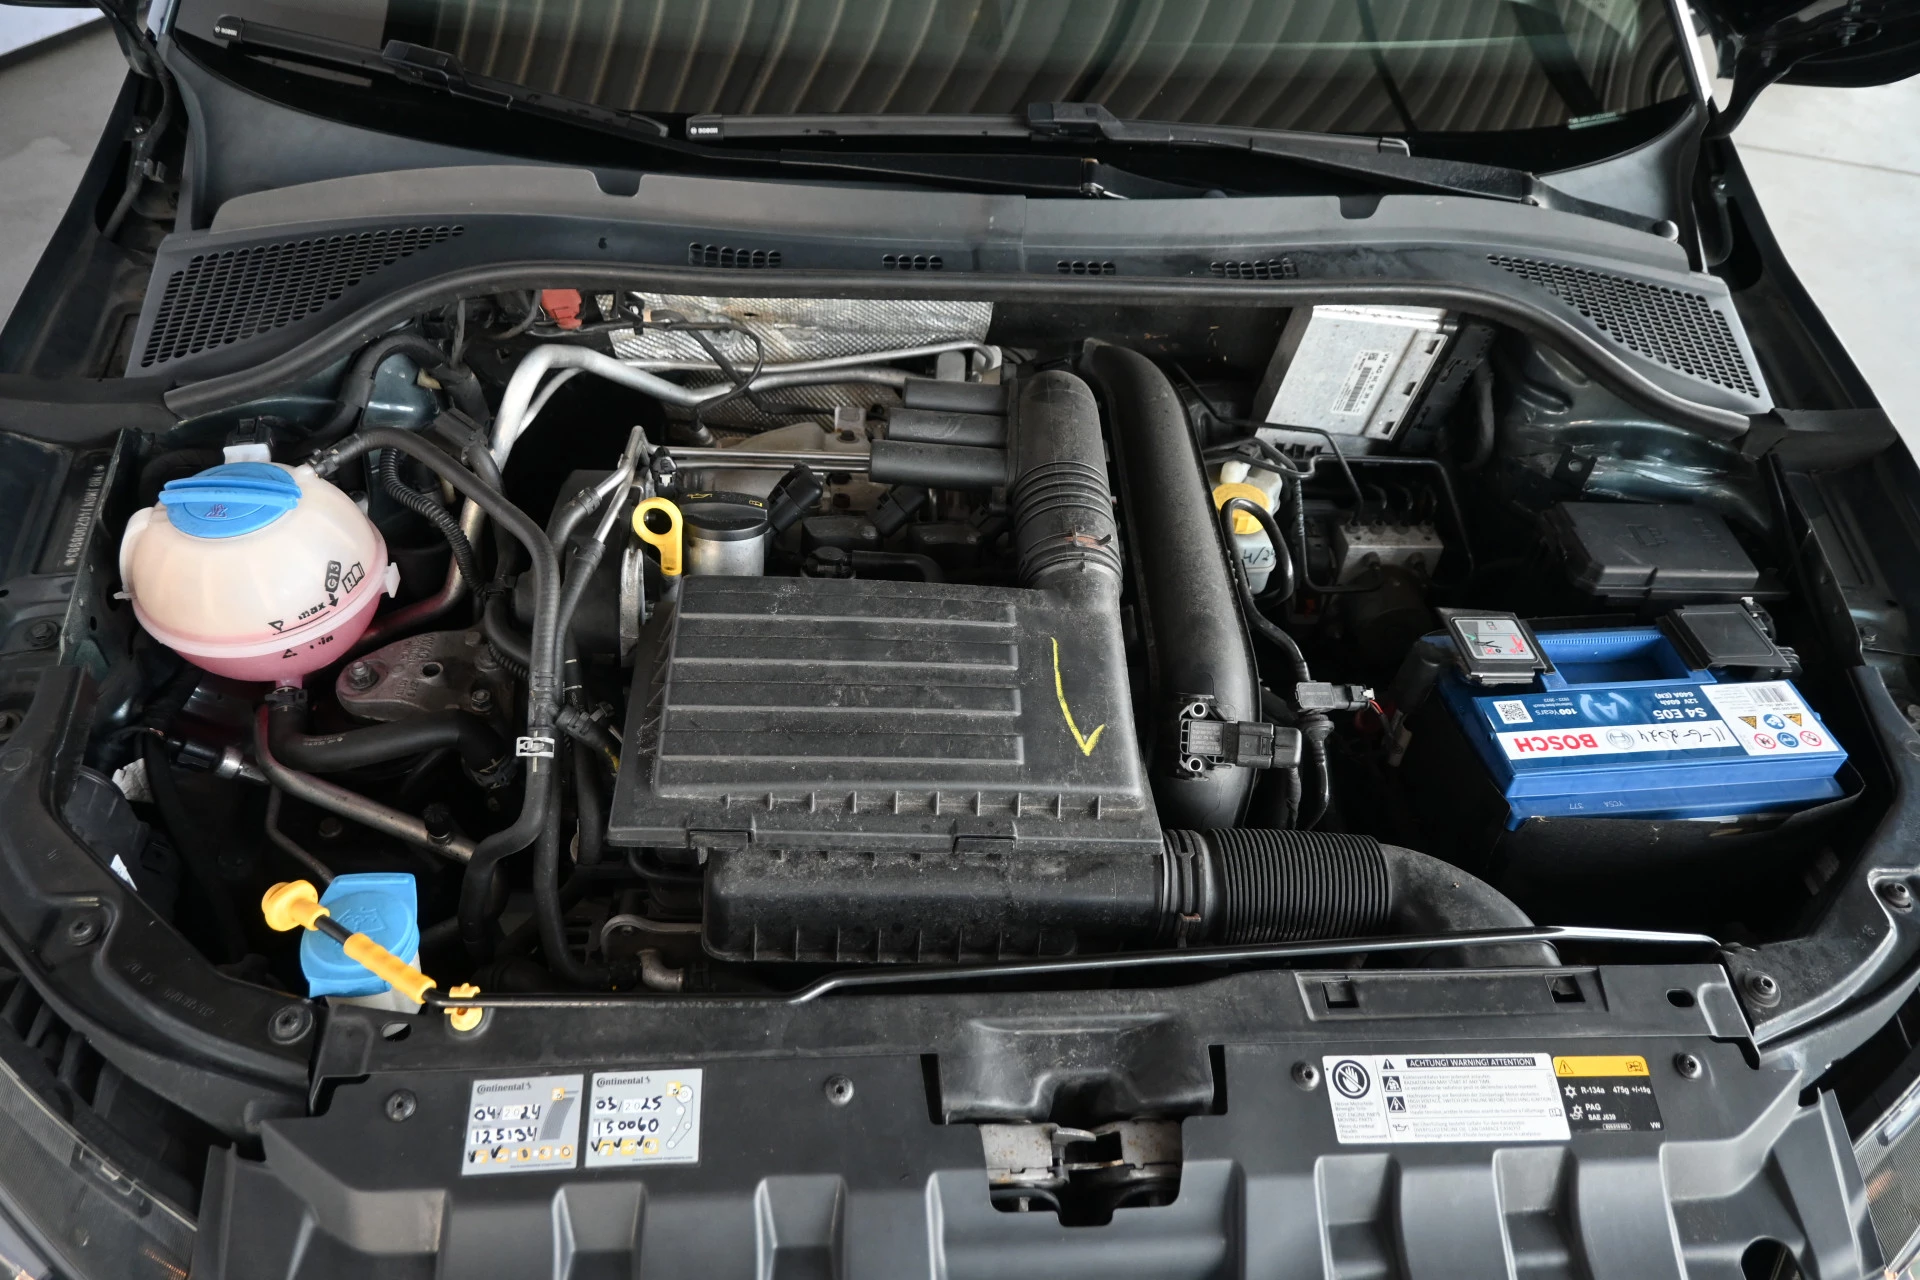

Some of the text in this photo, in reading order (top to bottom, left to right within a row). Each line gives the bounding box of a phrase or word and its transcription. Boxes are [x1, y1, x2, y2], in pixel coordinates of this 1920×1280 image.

[326, 563, 340, 589] G13
[1559, 707, 1578, 716] 100
[1652, 707, 1708, 720] S4 E05
[1513, 733, 1599, 753] BOSCH
[1409, 1057, 1534, 1067] ACHTUNG! WARNING! ATTENTION!
[596, 1076, 644, 1088] Continental
[477, 1082, 525, 1095] Continental
[1580, 1086, 1606, 1094] R-134a
[1612, 1086, 1630, 1095] 475g
[1585, 1103, 1602, 1111] PAG
